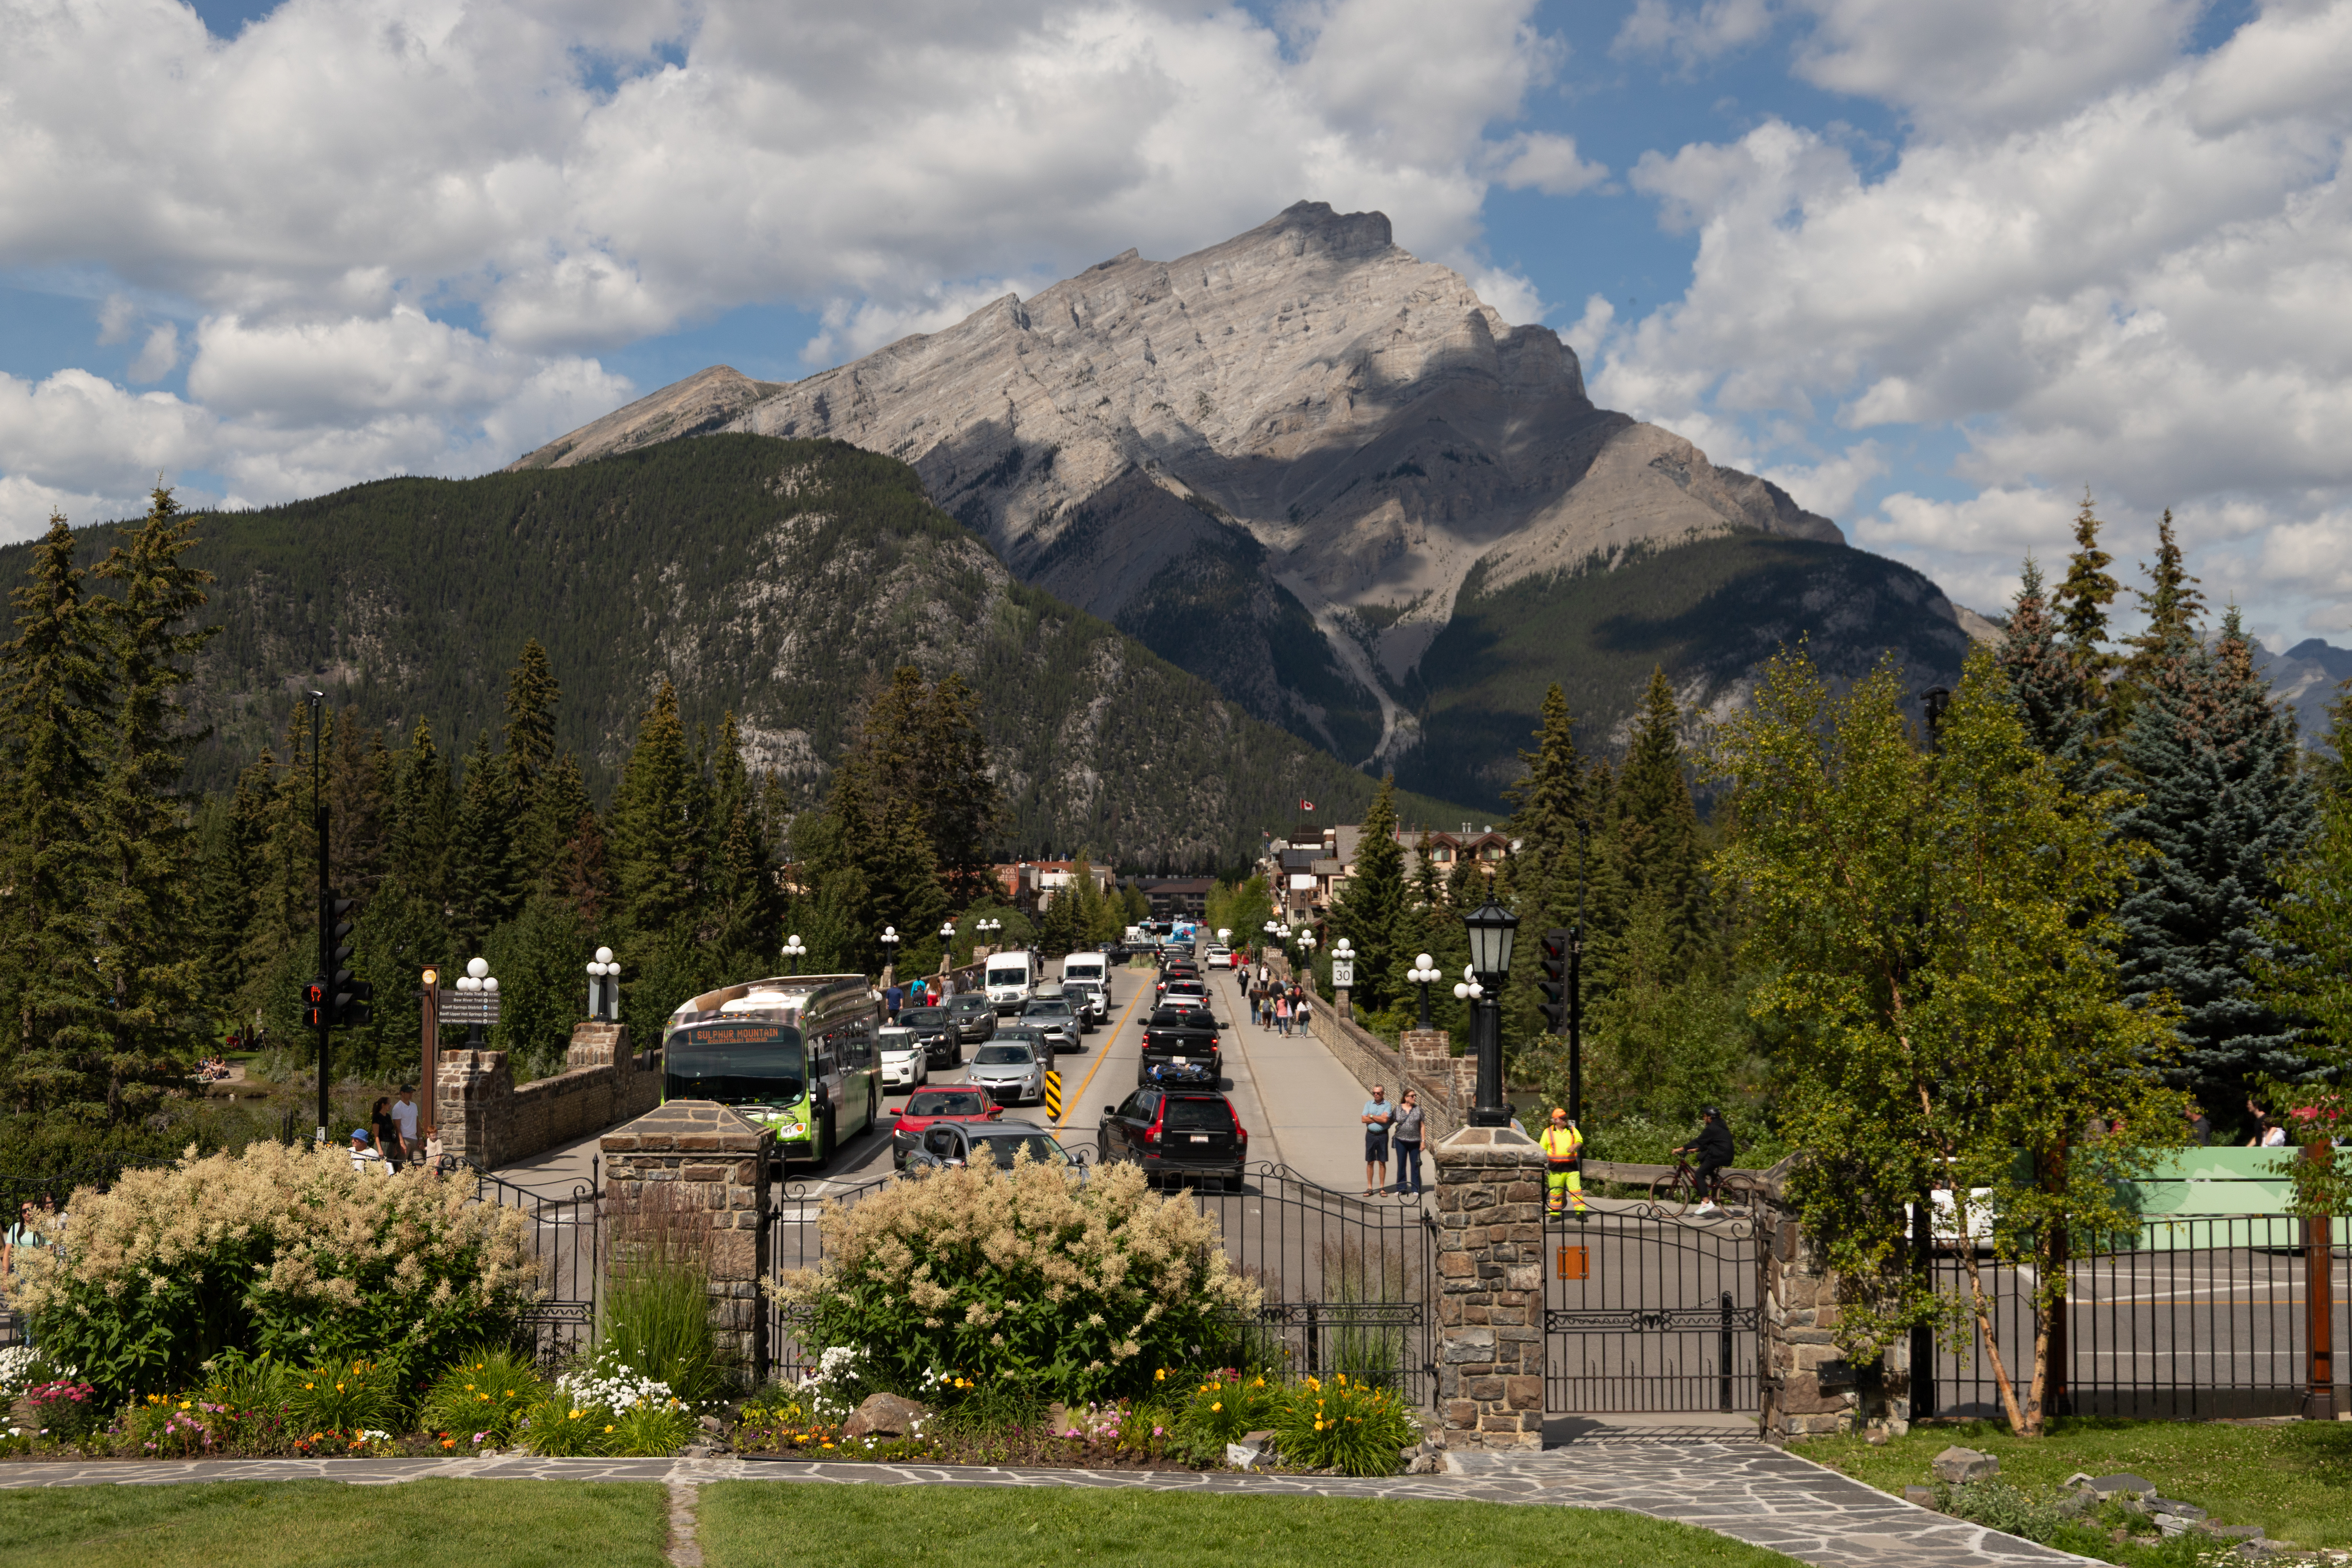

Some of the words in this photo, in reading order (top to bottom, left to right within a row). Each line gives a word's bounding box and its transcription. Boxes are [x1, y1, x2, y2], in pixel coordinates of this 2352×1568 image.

[1336, 970, 1350, 981] 30
[688, 1031, 692, 1044] 1
[697, 1030, 734, 1039] SULPHUR
[737, 1028, 778, 1037] MOUNTAIN
